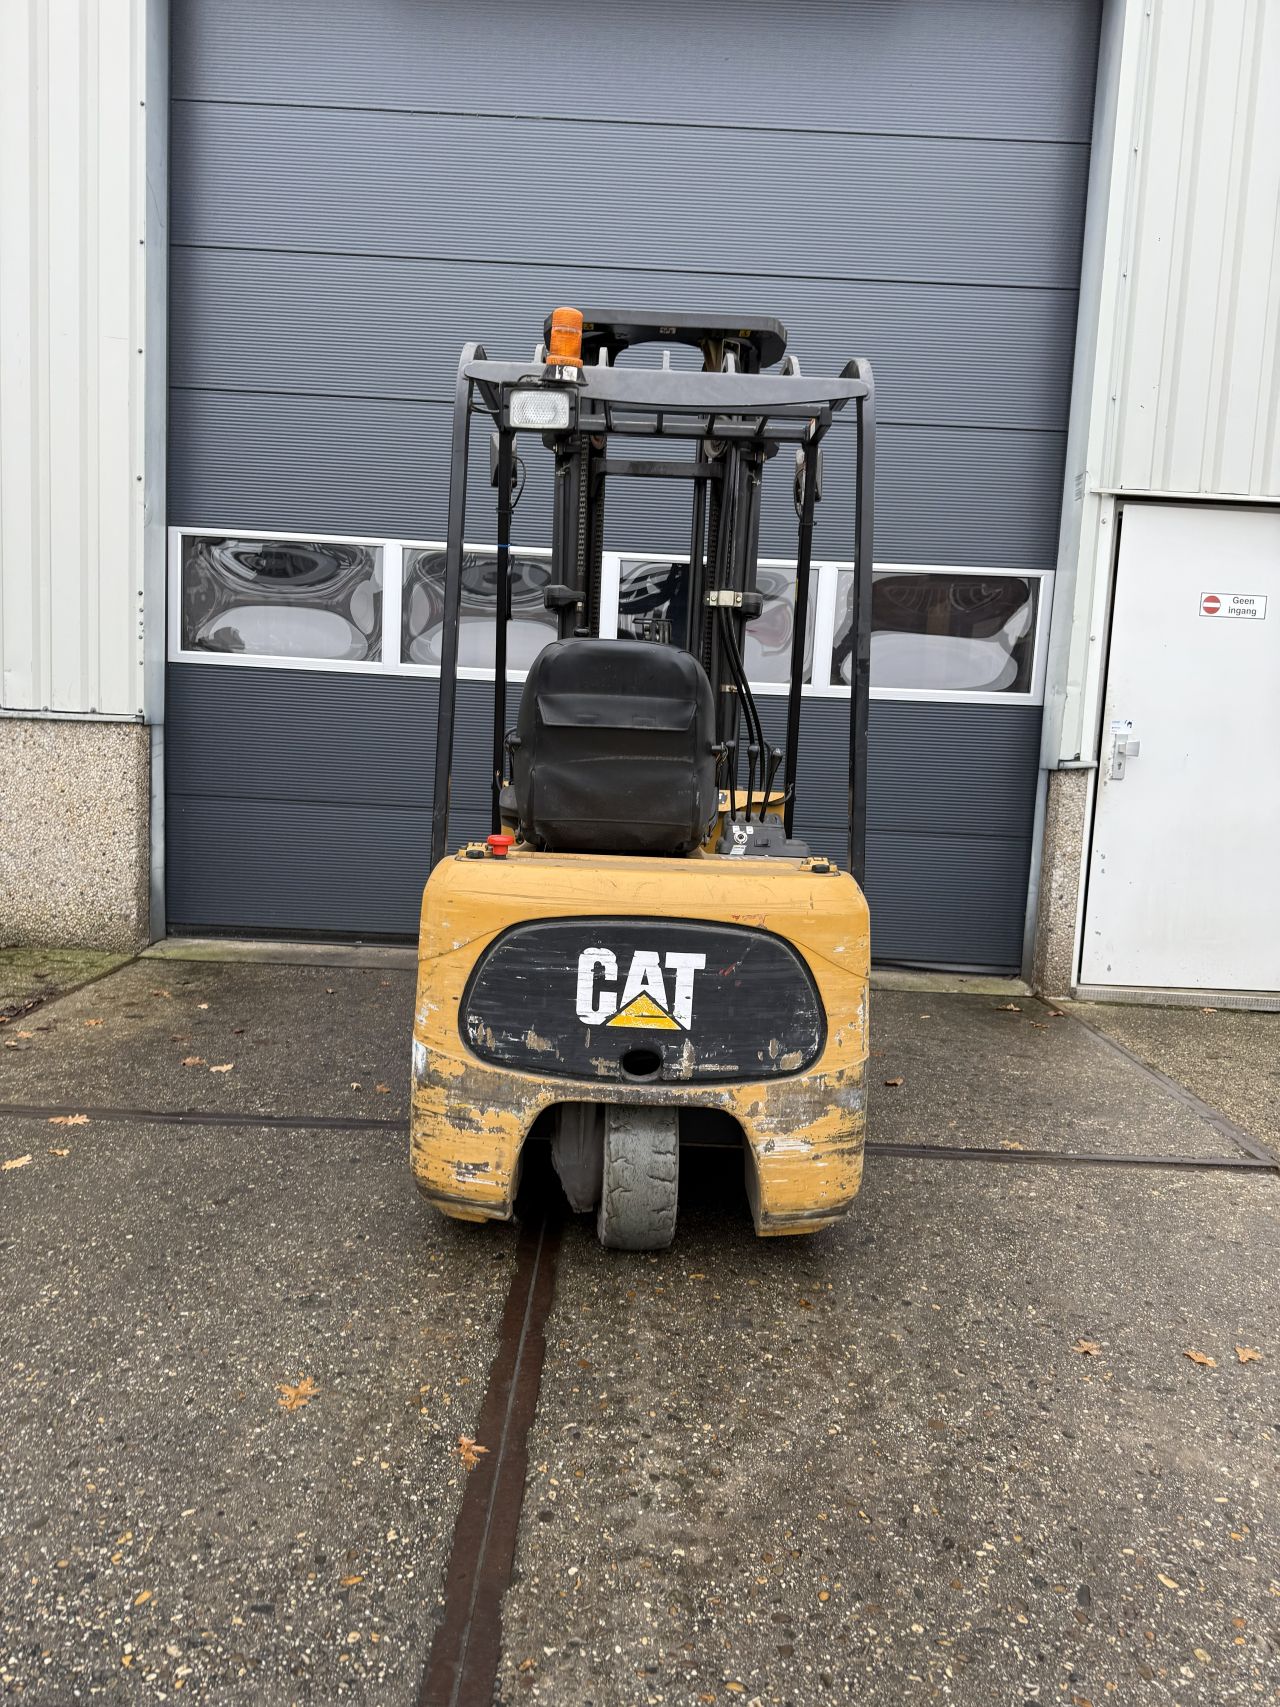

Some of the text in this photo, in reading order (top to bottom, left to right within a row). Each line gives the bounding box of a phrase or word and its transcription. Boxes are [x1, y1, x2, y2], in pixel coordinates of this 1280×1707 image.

[1232, 596, 1255, 605] Geen
[1228, 606, 1257, 617] ingang
[575, 947, 707, 1031] CAT
